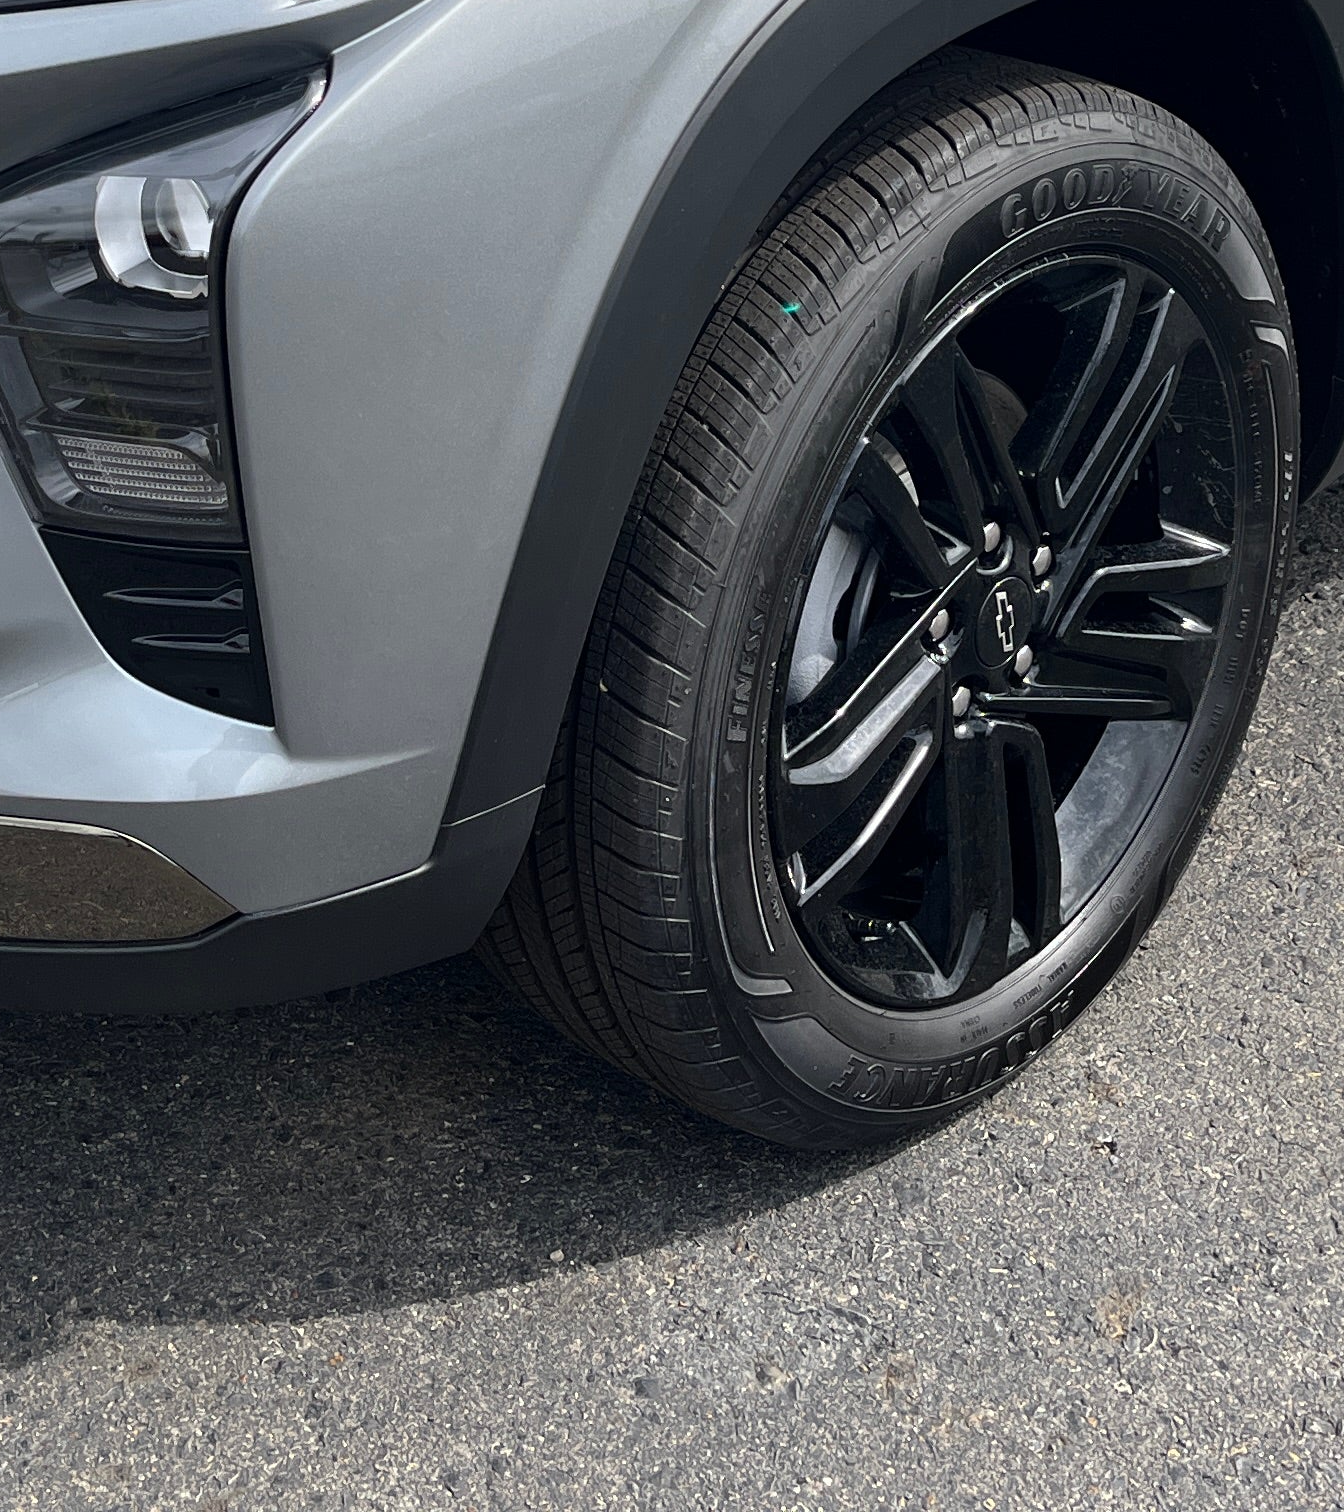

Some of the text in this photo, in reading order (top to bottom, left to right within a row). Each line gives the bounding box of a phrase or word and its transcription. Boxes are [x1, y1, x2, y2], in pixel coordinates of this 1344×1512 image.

[1000, 162, 1231, 253] GOODYEAR
[727, 591, 773, 743] FINESSE
[827, 990, 1075, 1107] ASSURANCE
